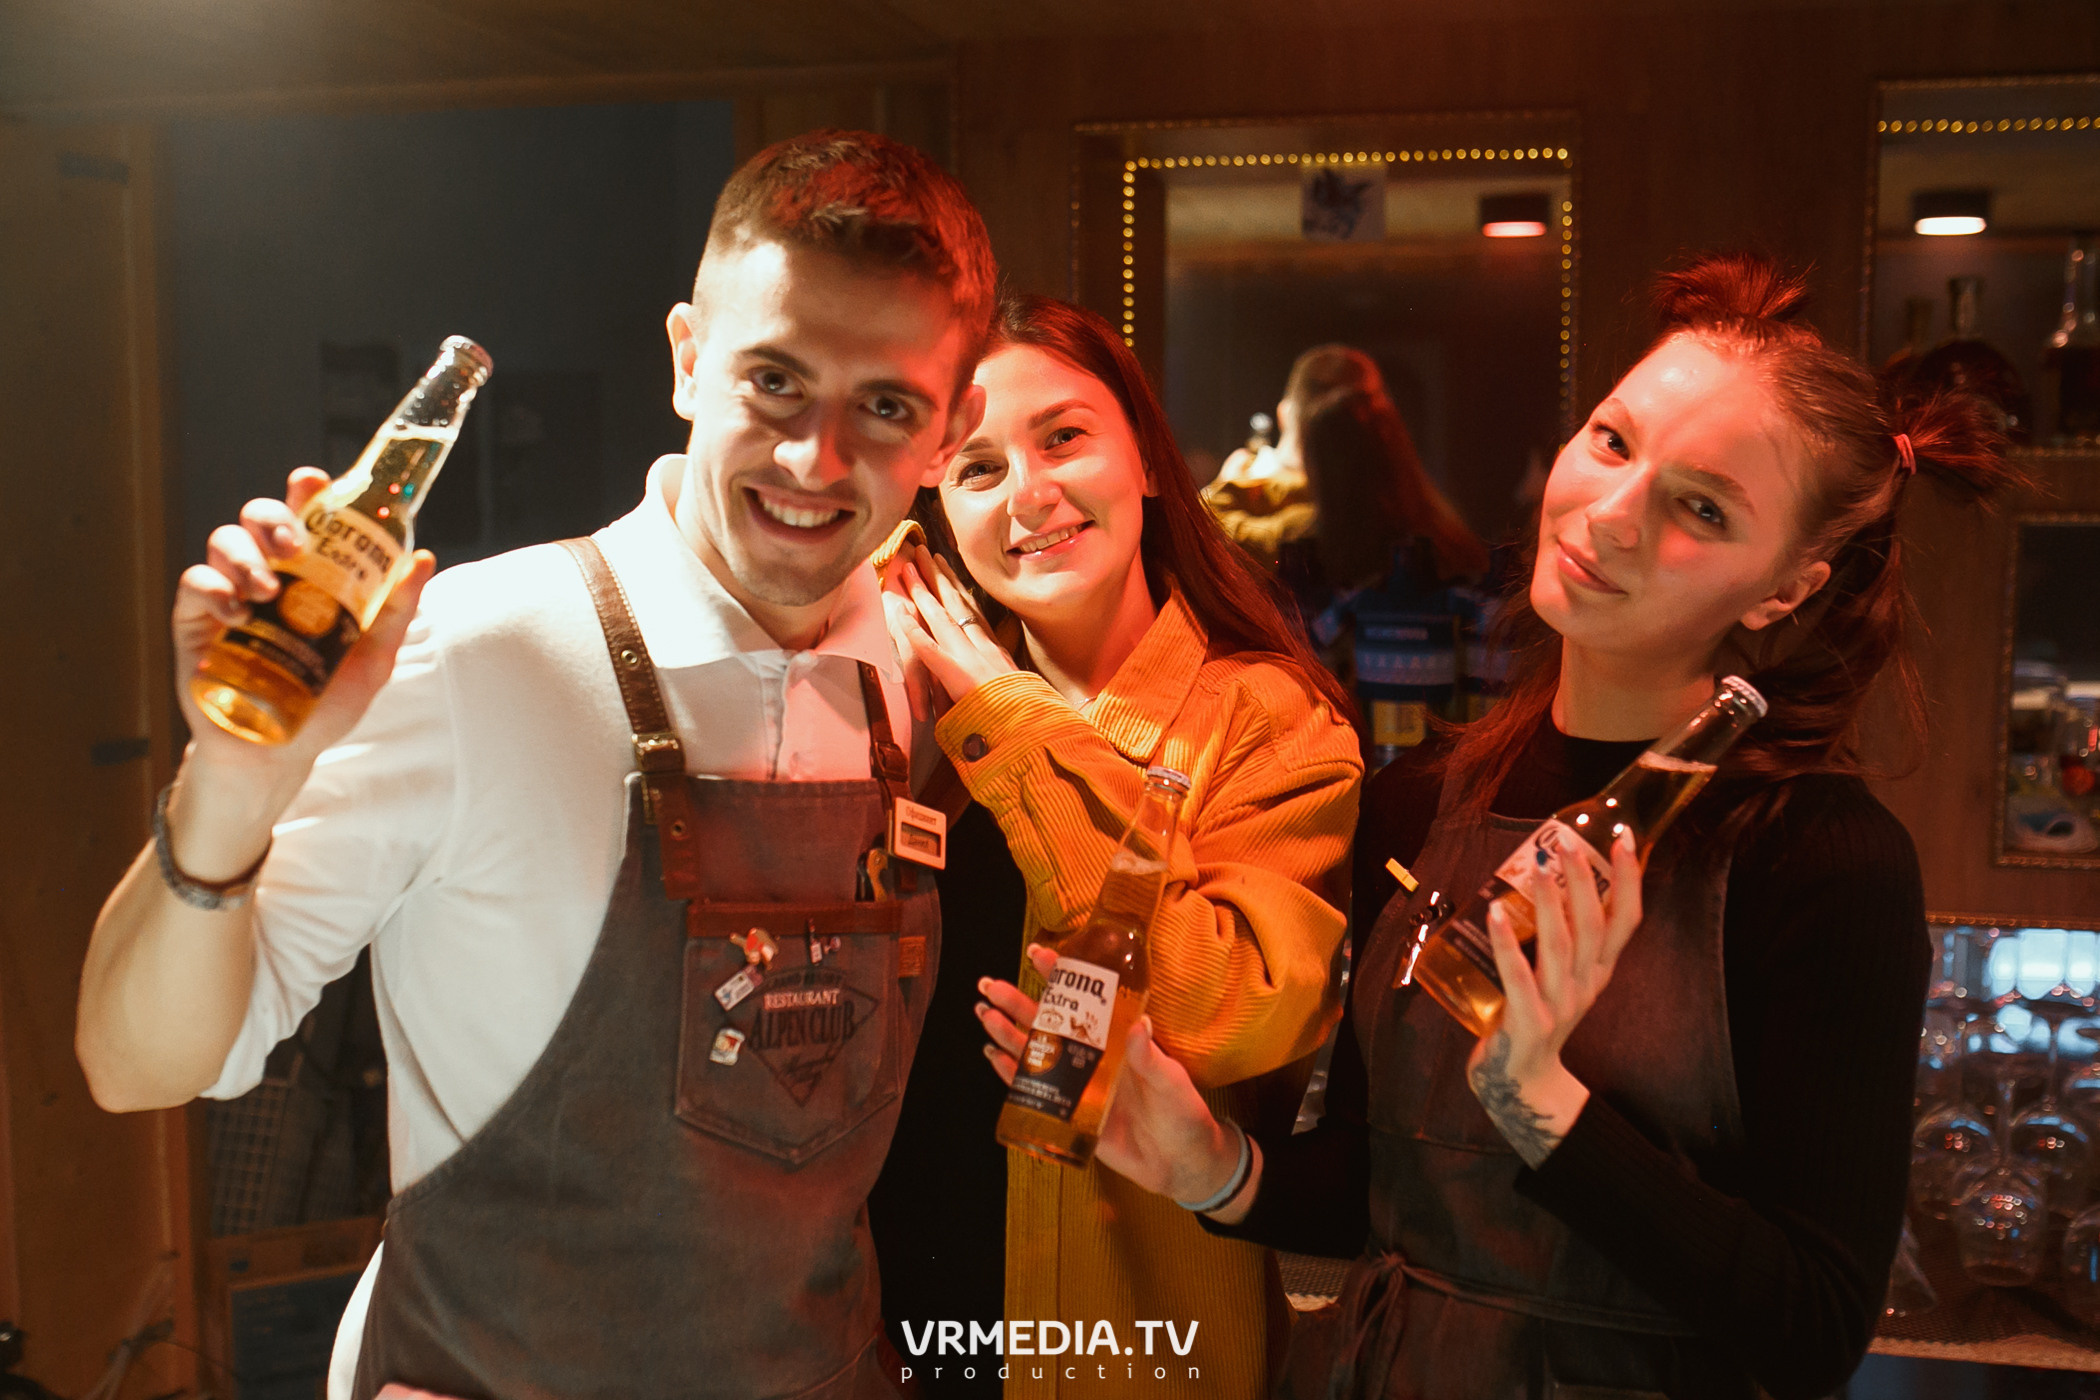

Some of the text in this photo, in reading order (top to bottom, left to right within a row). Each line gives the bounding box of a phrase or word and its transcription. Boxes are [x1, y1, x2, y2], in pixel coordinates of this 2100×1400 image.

[1048, 967, 1105, 998] orona
[763, 988, 840, 1010] RESTAURANT
[1043, 986, 1079, 1012] Extra
[808, 999, 856, 1045] CLUB
